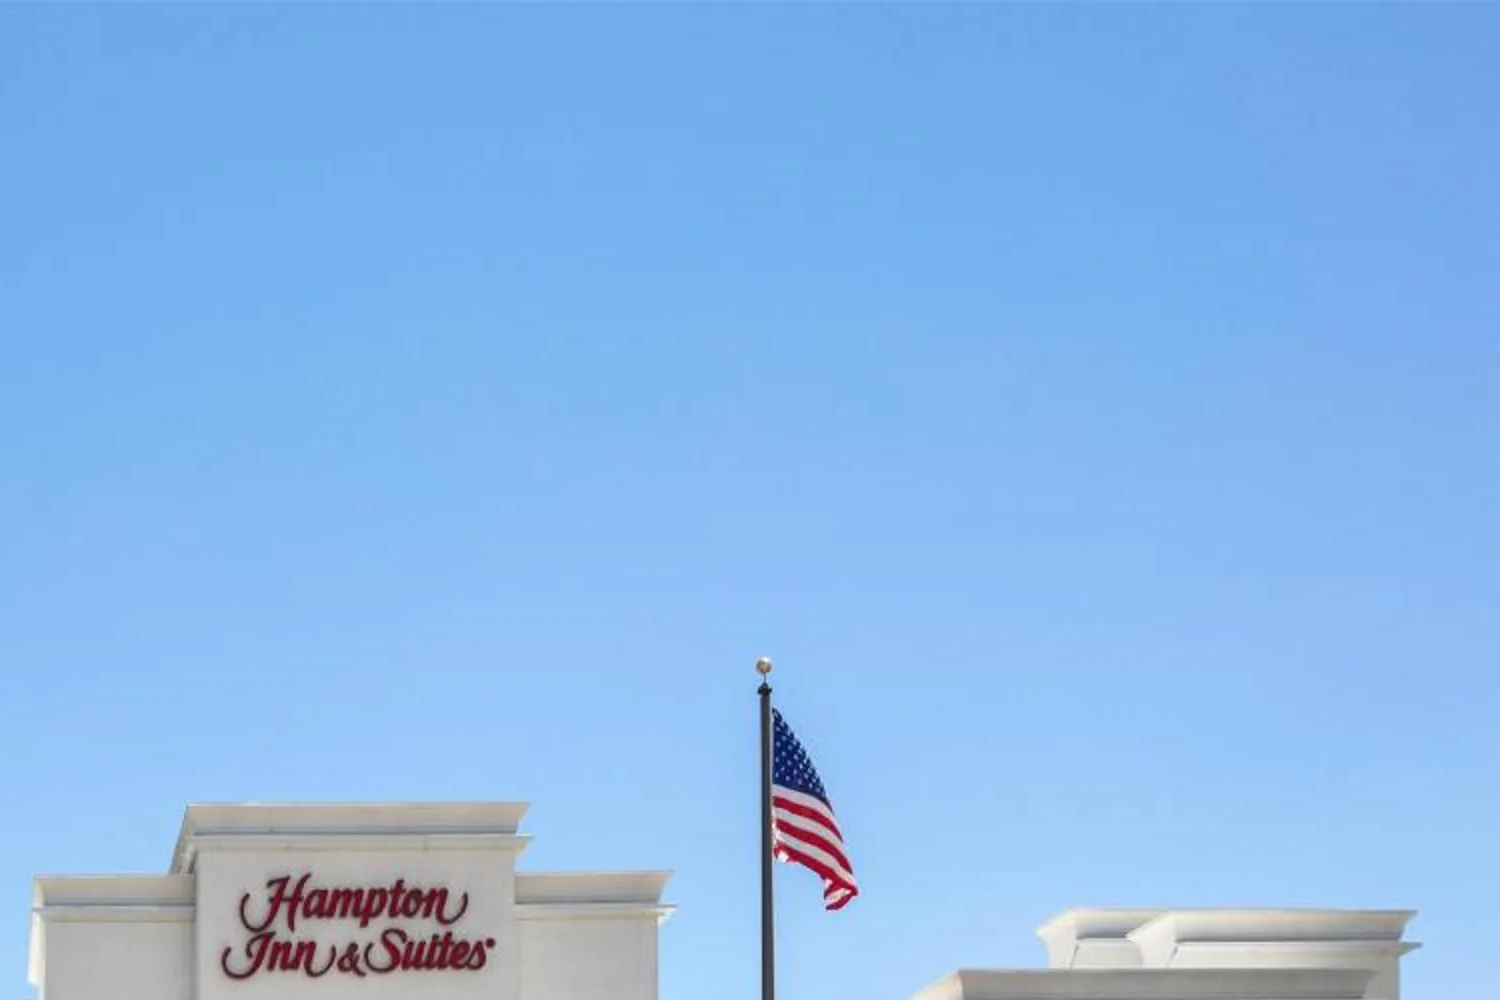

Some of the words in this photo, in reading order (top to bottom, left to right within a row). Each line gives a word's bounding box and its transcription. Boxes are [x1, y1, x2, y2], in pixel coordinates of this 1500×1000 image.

[240, 872, 469, 932] Hampton
[221, 931, 337, 979] Inn
[337, 941, 366, 977] &
